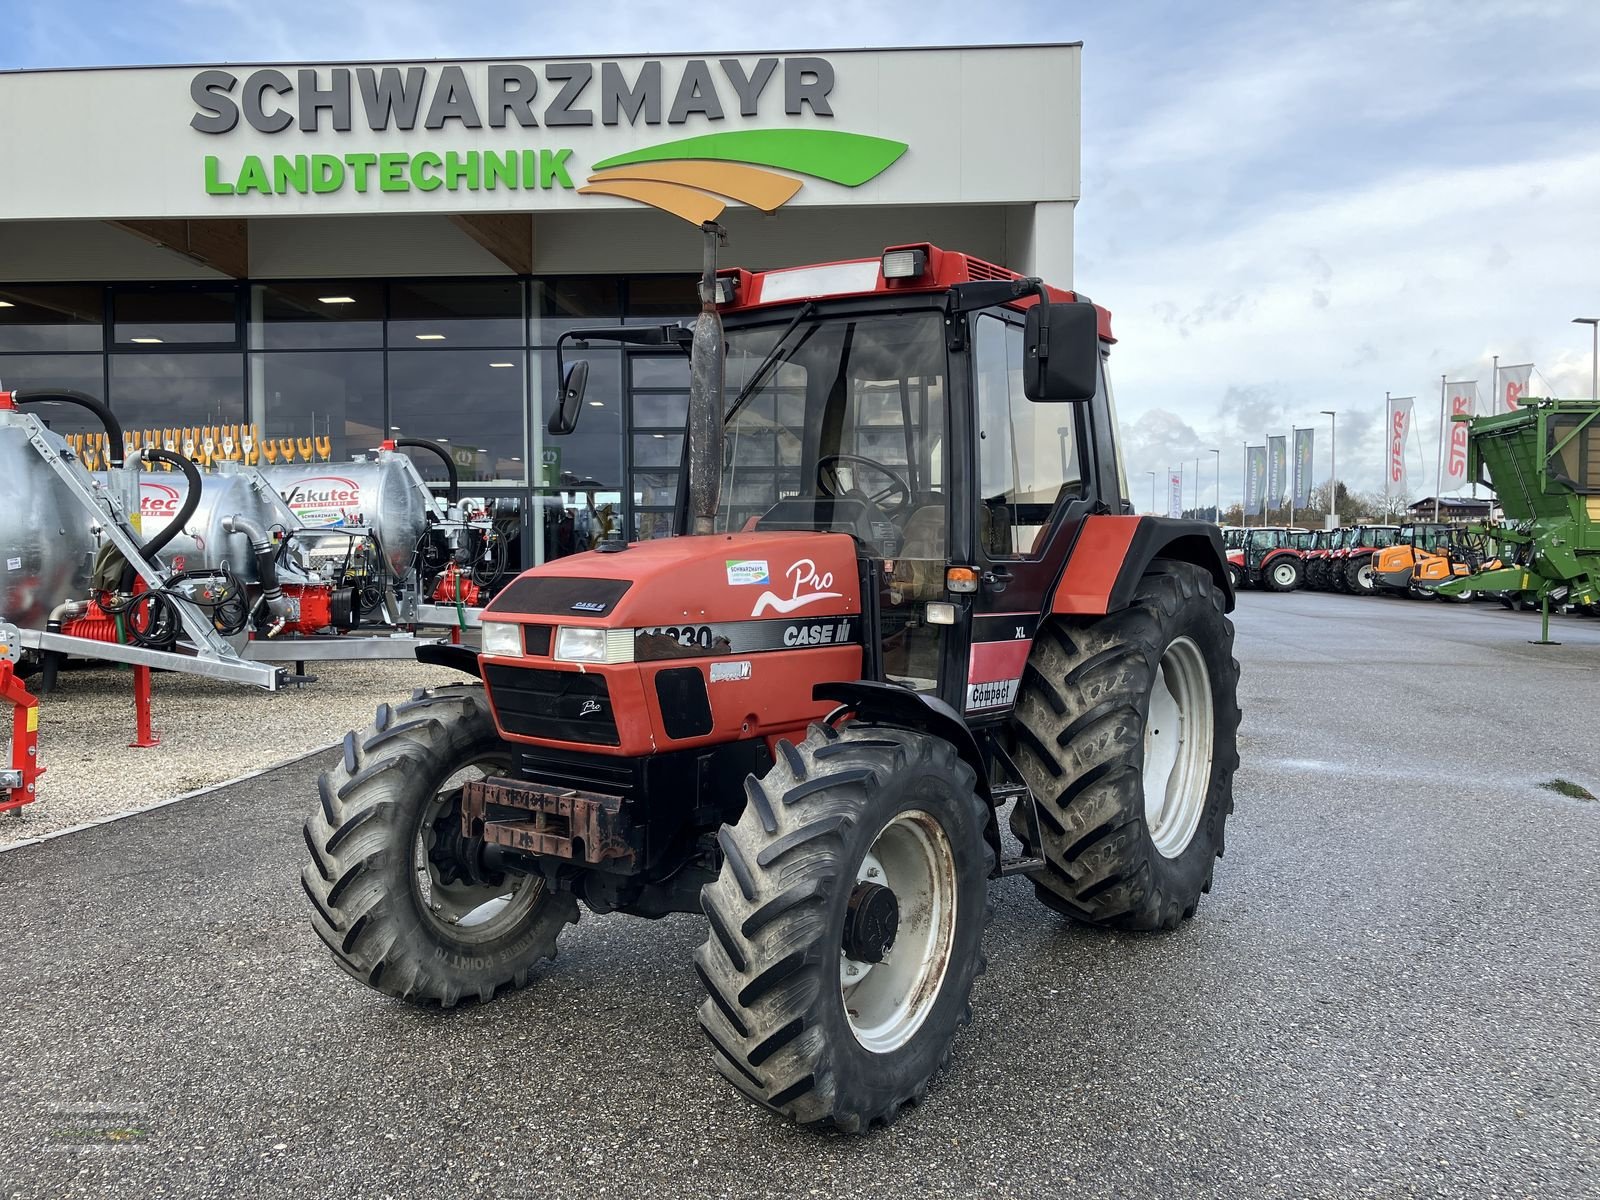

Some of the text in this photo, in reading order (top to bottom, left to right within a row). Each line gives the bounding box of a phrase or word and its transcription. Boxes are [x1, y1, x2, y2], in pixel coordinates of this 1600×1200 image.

[190, 57, 835, 134] SCHWARZMAYR
[204, 148, 574, 195] LANDTECHNIK
[1392, 410, 1405, 482] STEYR
[280, 486, 360, 505] Vakutec
[785, 559, 833, 600] Pro
[783, 624, 834, 646] CASE
[1014, 626, 1026, 639] XL
[972, 685, 1009, 704] Compact
[582, 700, 601, 711] Pro
[450, 955, 494, 972] POINT
